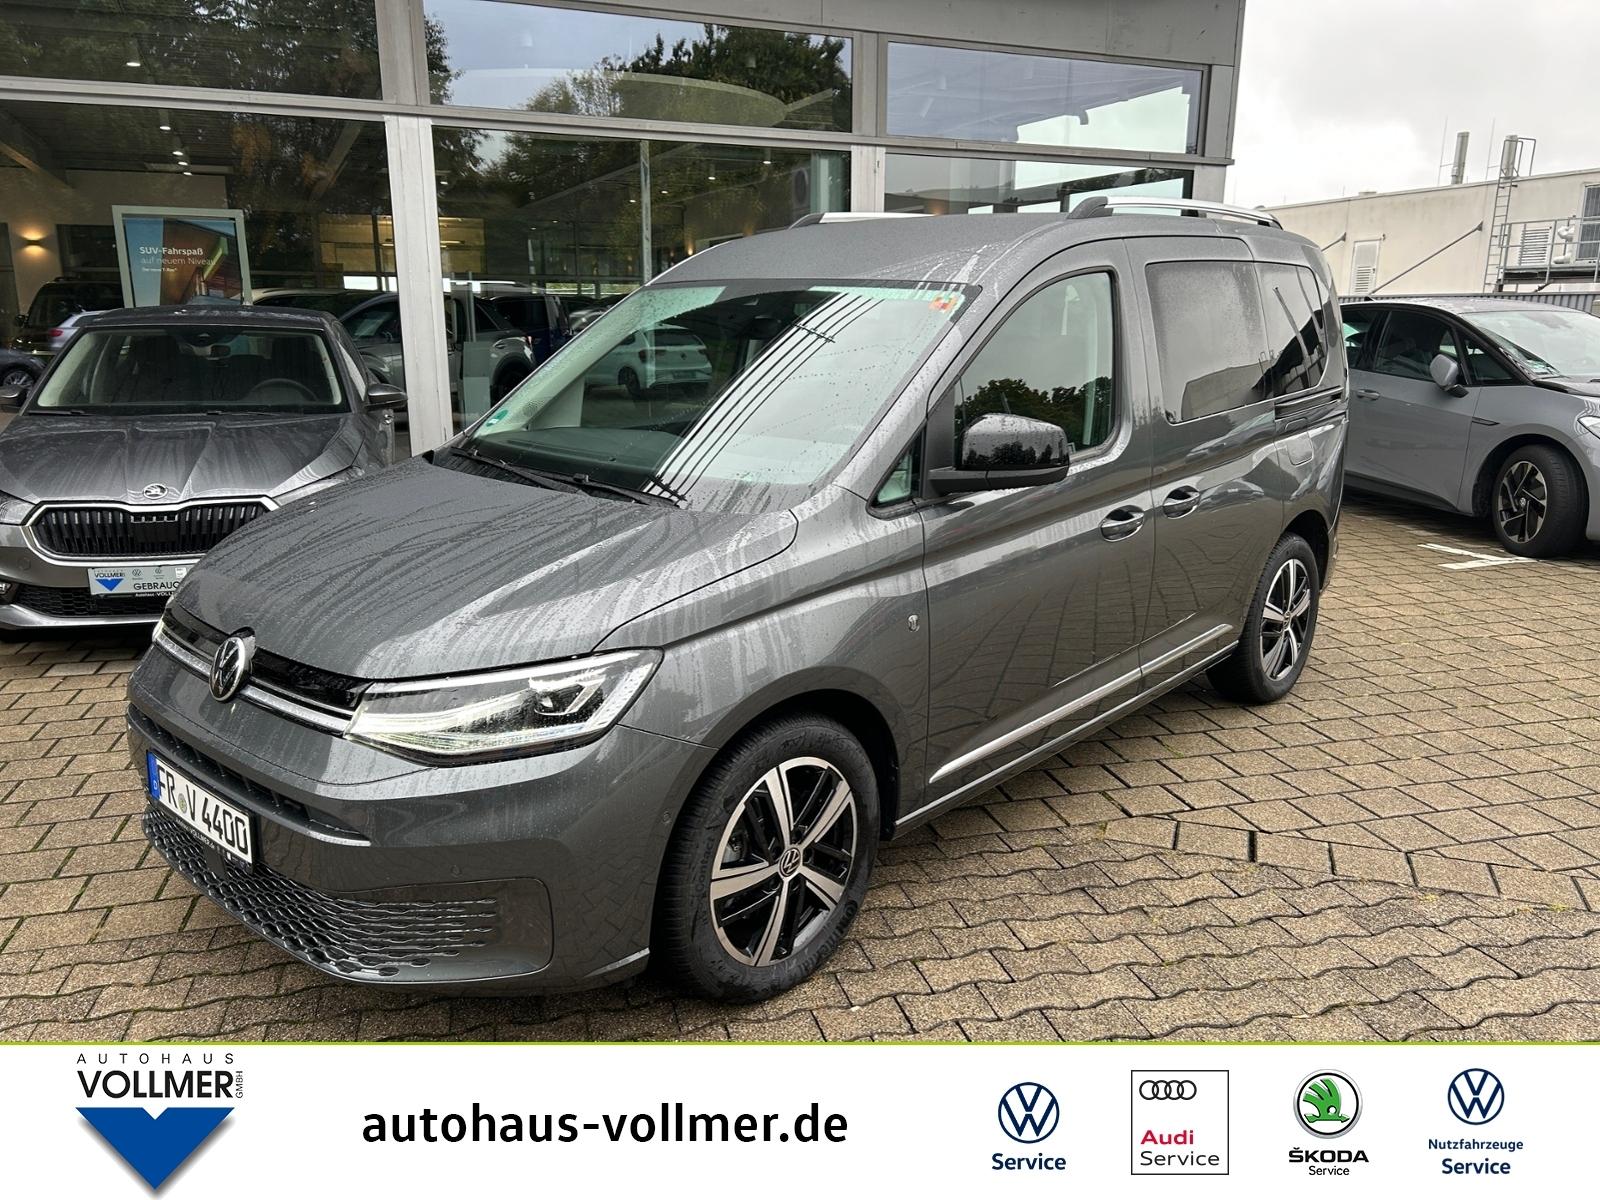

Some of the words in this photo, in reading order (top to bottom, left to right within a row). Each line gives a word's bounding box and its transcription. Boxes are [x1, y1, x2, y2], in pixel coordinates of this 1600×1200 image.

[139, 246, 204, 256] SUV-Fahrspaß
[141, 256, 154, 265] auf
[157, 764, 178, 809] FR
[185, 783, 196, 822] V
[201, 797, 249, 856] 4400
